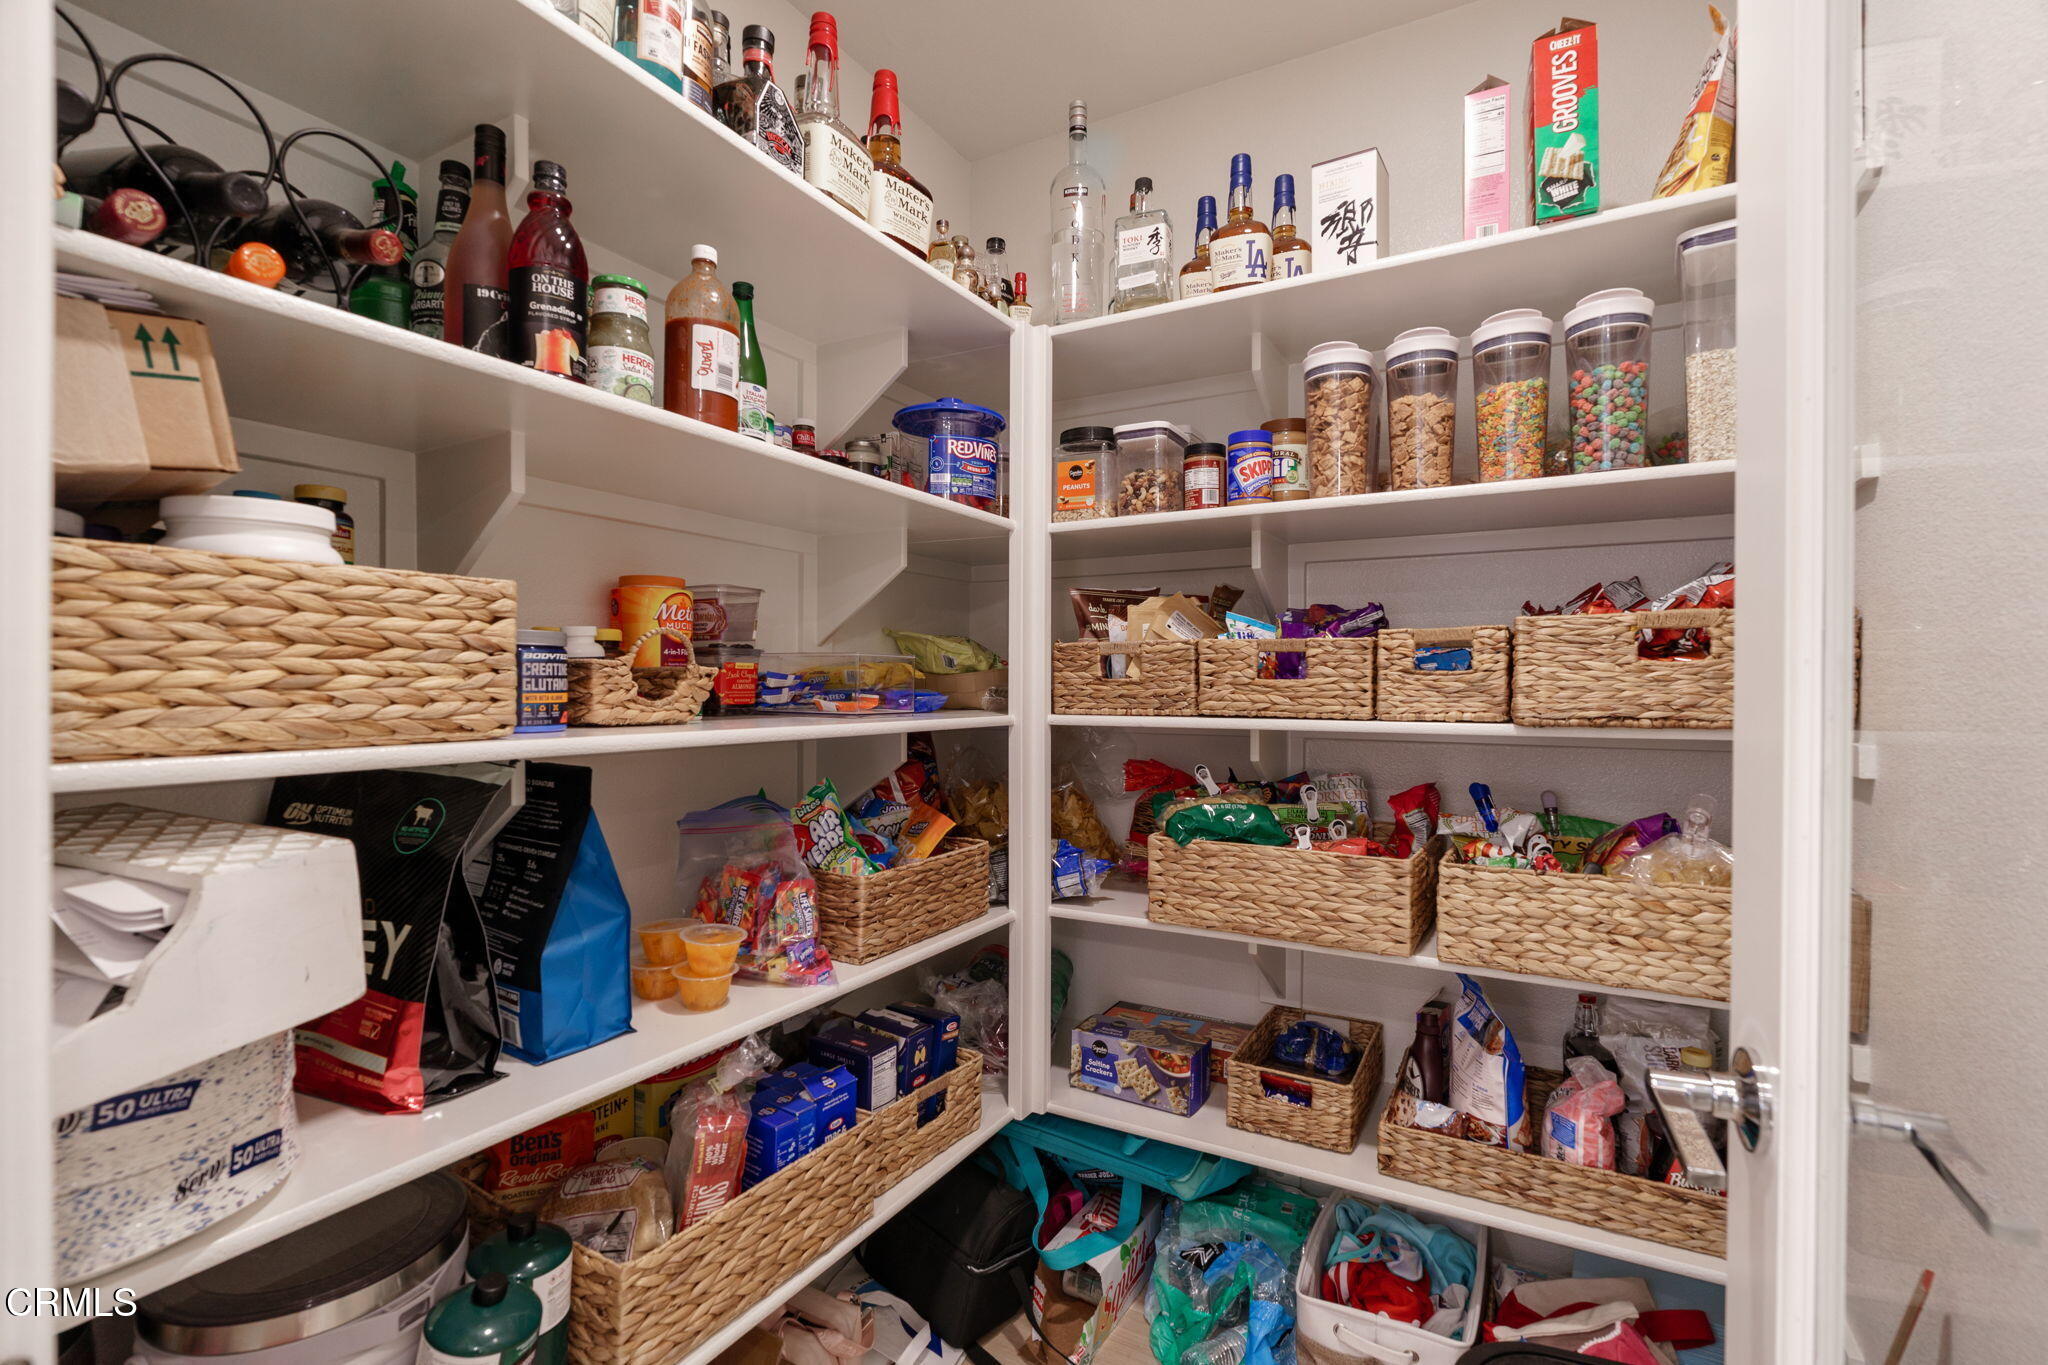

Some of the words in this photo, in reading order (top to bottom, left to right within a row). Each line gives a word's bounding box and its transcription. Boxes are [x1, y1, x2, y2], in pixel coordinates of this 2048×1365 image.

[1549, 34, 1581, 51] CHEEZ-IT
[1551, 49, 1578, 133] GROOVES
[830, 133, 872, 176] Maker's
[837, 171, 865, 196] WHISKY
[842, 159, 870, 190] Mark
[885, 177, 931, 212] Maker's
[1550, 180, 1579, 198] WHITE
[892, 210, 922, 231] WHISKY
[899, 198, 929, 225] Mark
[1123, 235, 1143, 244] TOKI
[1214, 247, 1242, 257] Maker's
[1221, 253, 1242, 261] Mark
[1245, 240, 1267, 278] LA
[531, 273, 549, 284] ON
[551, 276, 574, 290] THE
[532, 282, 574, 300] HOUSE
[1186, 281, 1213, 289] Maker's
[476, 288, 489, 298] 19
[529, 301, 576, 318] Grenadine
[1273, 459, 1294, 478] if
[1062, 482, 1090, 491] PEANUTS
[316, 804, 354, 816] OPTIMUM
[796, 798, 820, 818] bites
[314, 814, 354, 826] NUTRITION
[809, 809, 840, 843] AIR
[362, 920, 413, 981] EY
[820, 1051, 836, 1059] LARGE
[838, 1055, 855, 1065] SHELLS
[1088, 1058, 1110, 1070] Saltine
[1663, 1046, 1681, 1072] DARK
[1084, 1065, 1113, 1078] Crackers
[98, 1099, 134, 1124] 50
[139, 1085, 196, 1110] ULTRA
[591, 1097, 628, 1121] TEIN+
[230, 1146, 253, 1173] 50
[254, 1133, 281, 1154] ULTRA
[510, 1131, 562, 1155] Ben's
[510, 1150, 561, 1167] Original
[704, 1144, 713, 1165] 100%
[711, 1143, 721, 1166] Whole
[718, 1142, 728, 1165] Wheat
[499, 1168, 546, 1187] Ready
[1104, 1230, 1148, 1322] Squirt
